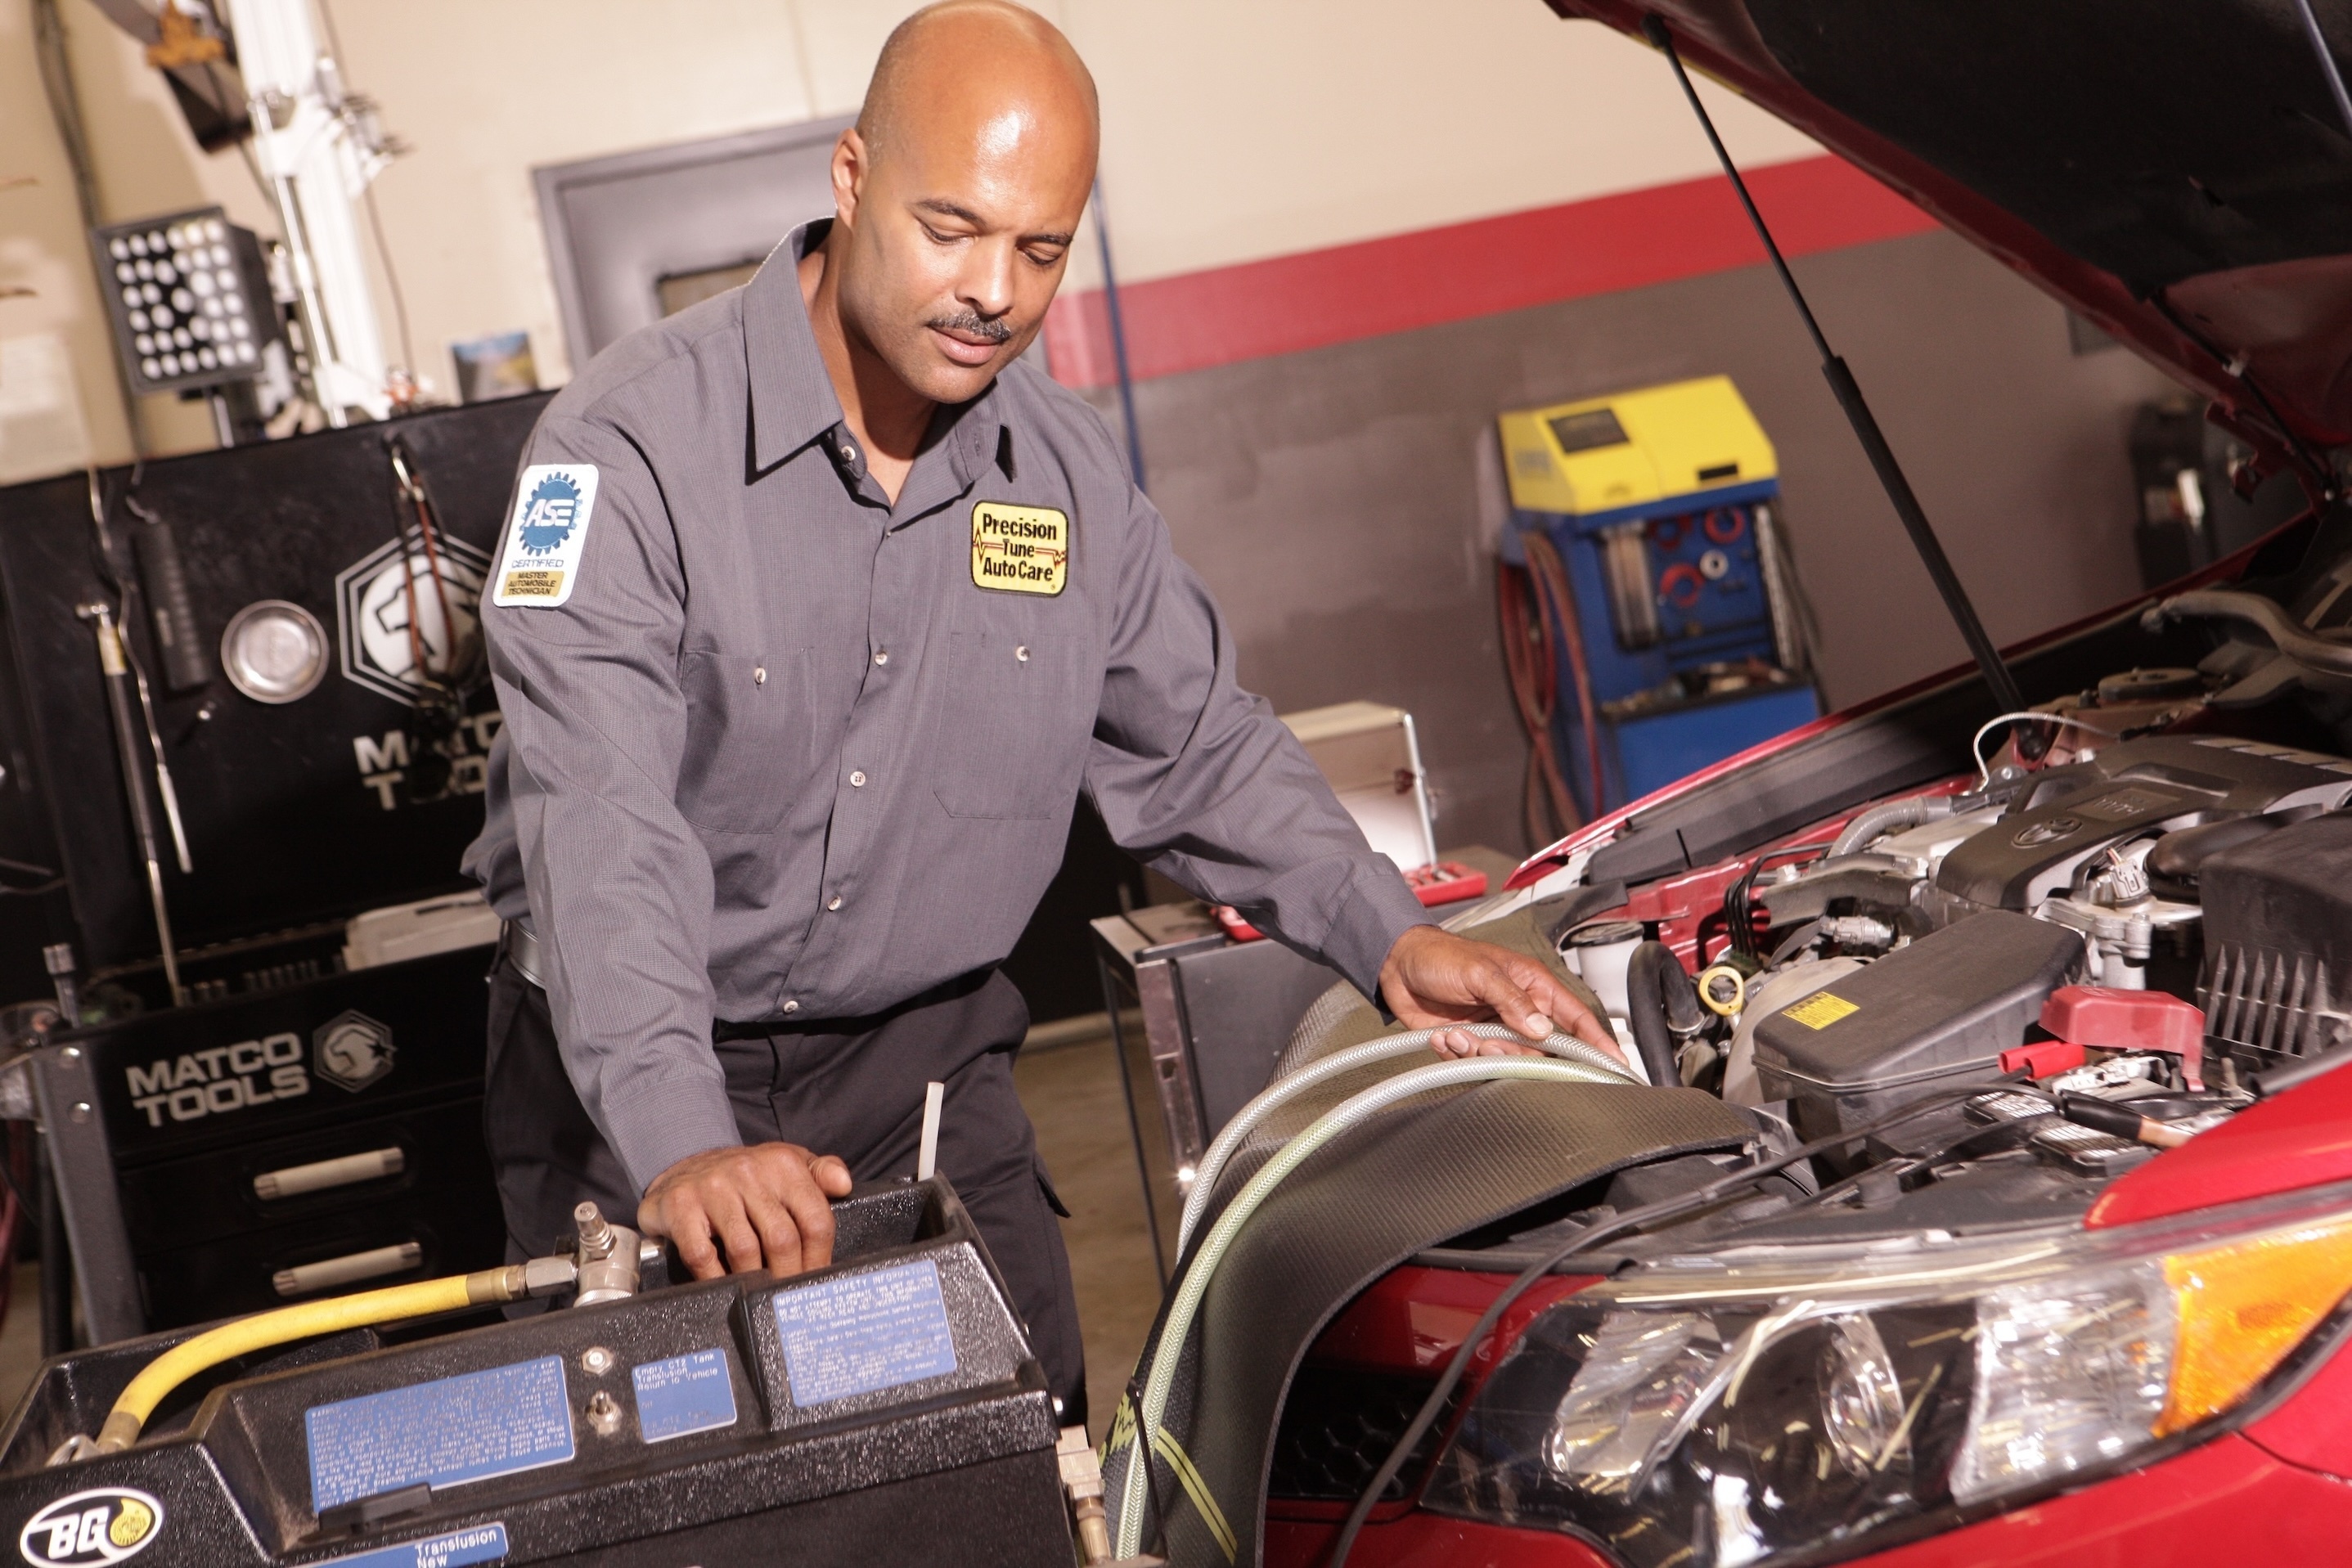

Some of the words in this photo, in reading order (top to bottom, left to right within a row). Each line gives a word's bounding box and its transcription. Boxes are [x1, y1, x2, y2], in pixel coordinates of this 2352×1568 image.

[524, 499, 574, 528] ASE
[983, 513, 1057, 540] Precision
[1002, 538, 1035, 557] Tune
[510, 559, 564, 568] CERTIFIED
[507, 579, 556, 587] AUTOMOBILE
[507, 586, 551, 595] TECHNICIAN
[126, 1031, 304, 1098] MATCO
[133, 1066, 310, 1129] TOOLS
[776, 1288, 827, 1307] IMPORTANT
[833, 1278, 868, 1294] SAFETY
[873, 1265, 930, 1285] INFORMATION
[635, 1364, 663, 1377] Empty
[668, 1359, 686, 1369] CT2
[693, 1353, 715, 1364] Tank
[637, 1367, 687, 1384] Transfusion
[637, 1380, 666, 1392] Return
[686, 1368, 718, 1381] Vehicle
[47, 1506, 110, 1560] BG
[415, 1529, 497, 1558] Transfusion
[416, 1554, 447, 1568] New
